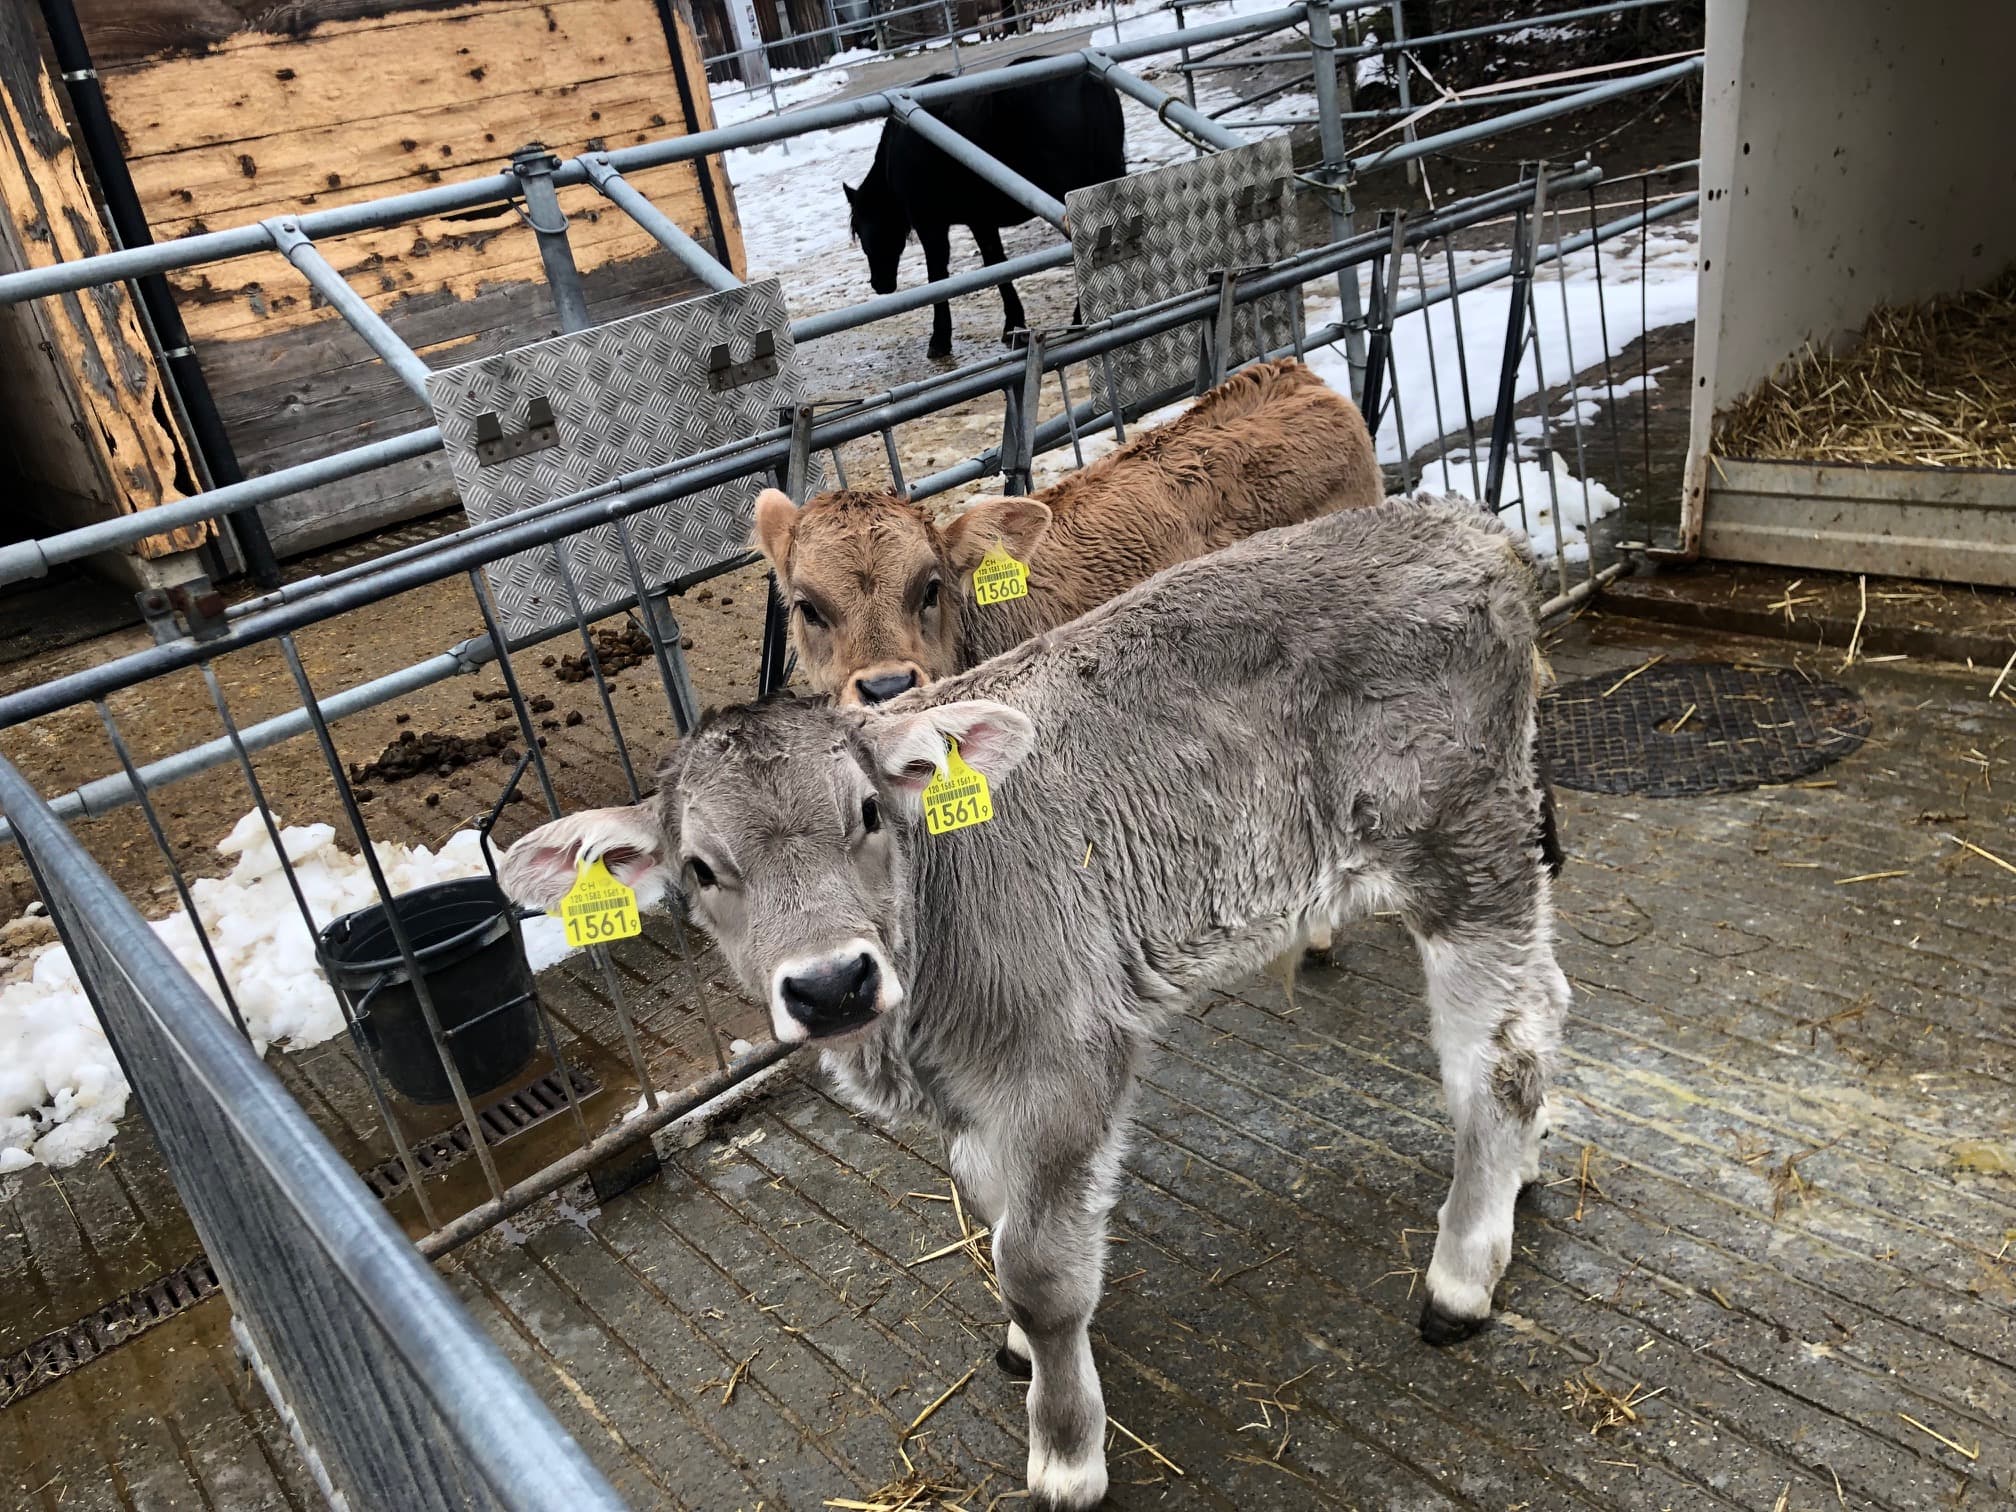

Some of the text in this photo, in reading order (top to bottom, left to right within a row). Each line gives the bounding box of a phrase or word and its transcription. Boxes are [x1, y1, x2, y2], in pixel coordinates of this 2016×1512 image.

[977, 578, 1020, 602] 1560
[928, 785, 939, 794] 120
[957, 776, 971, 786] 1561
[927, 796, 988, 830] 1561 9
[579, 882, 596, 891] CH
[570, 894, 582, 904] 120
[568, 909, 637, 942] 1561 9
